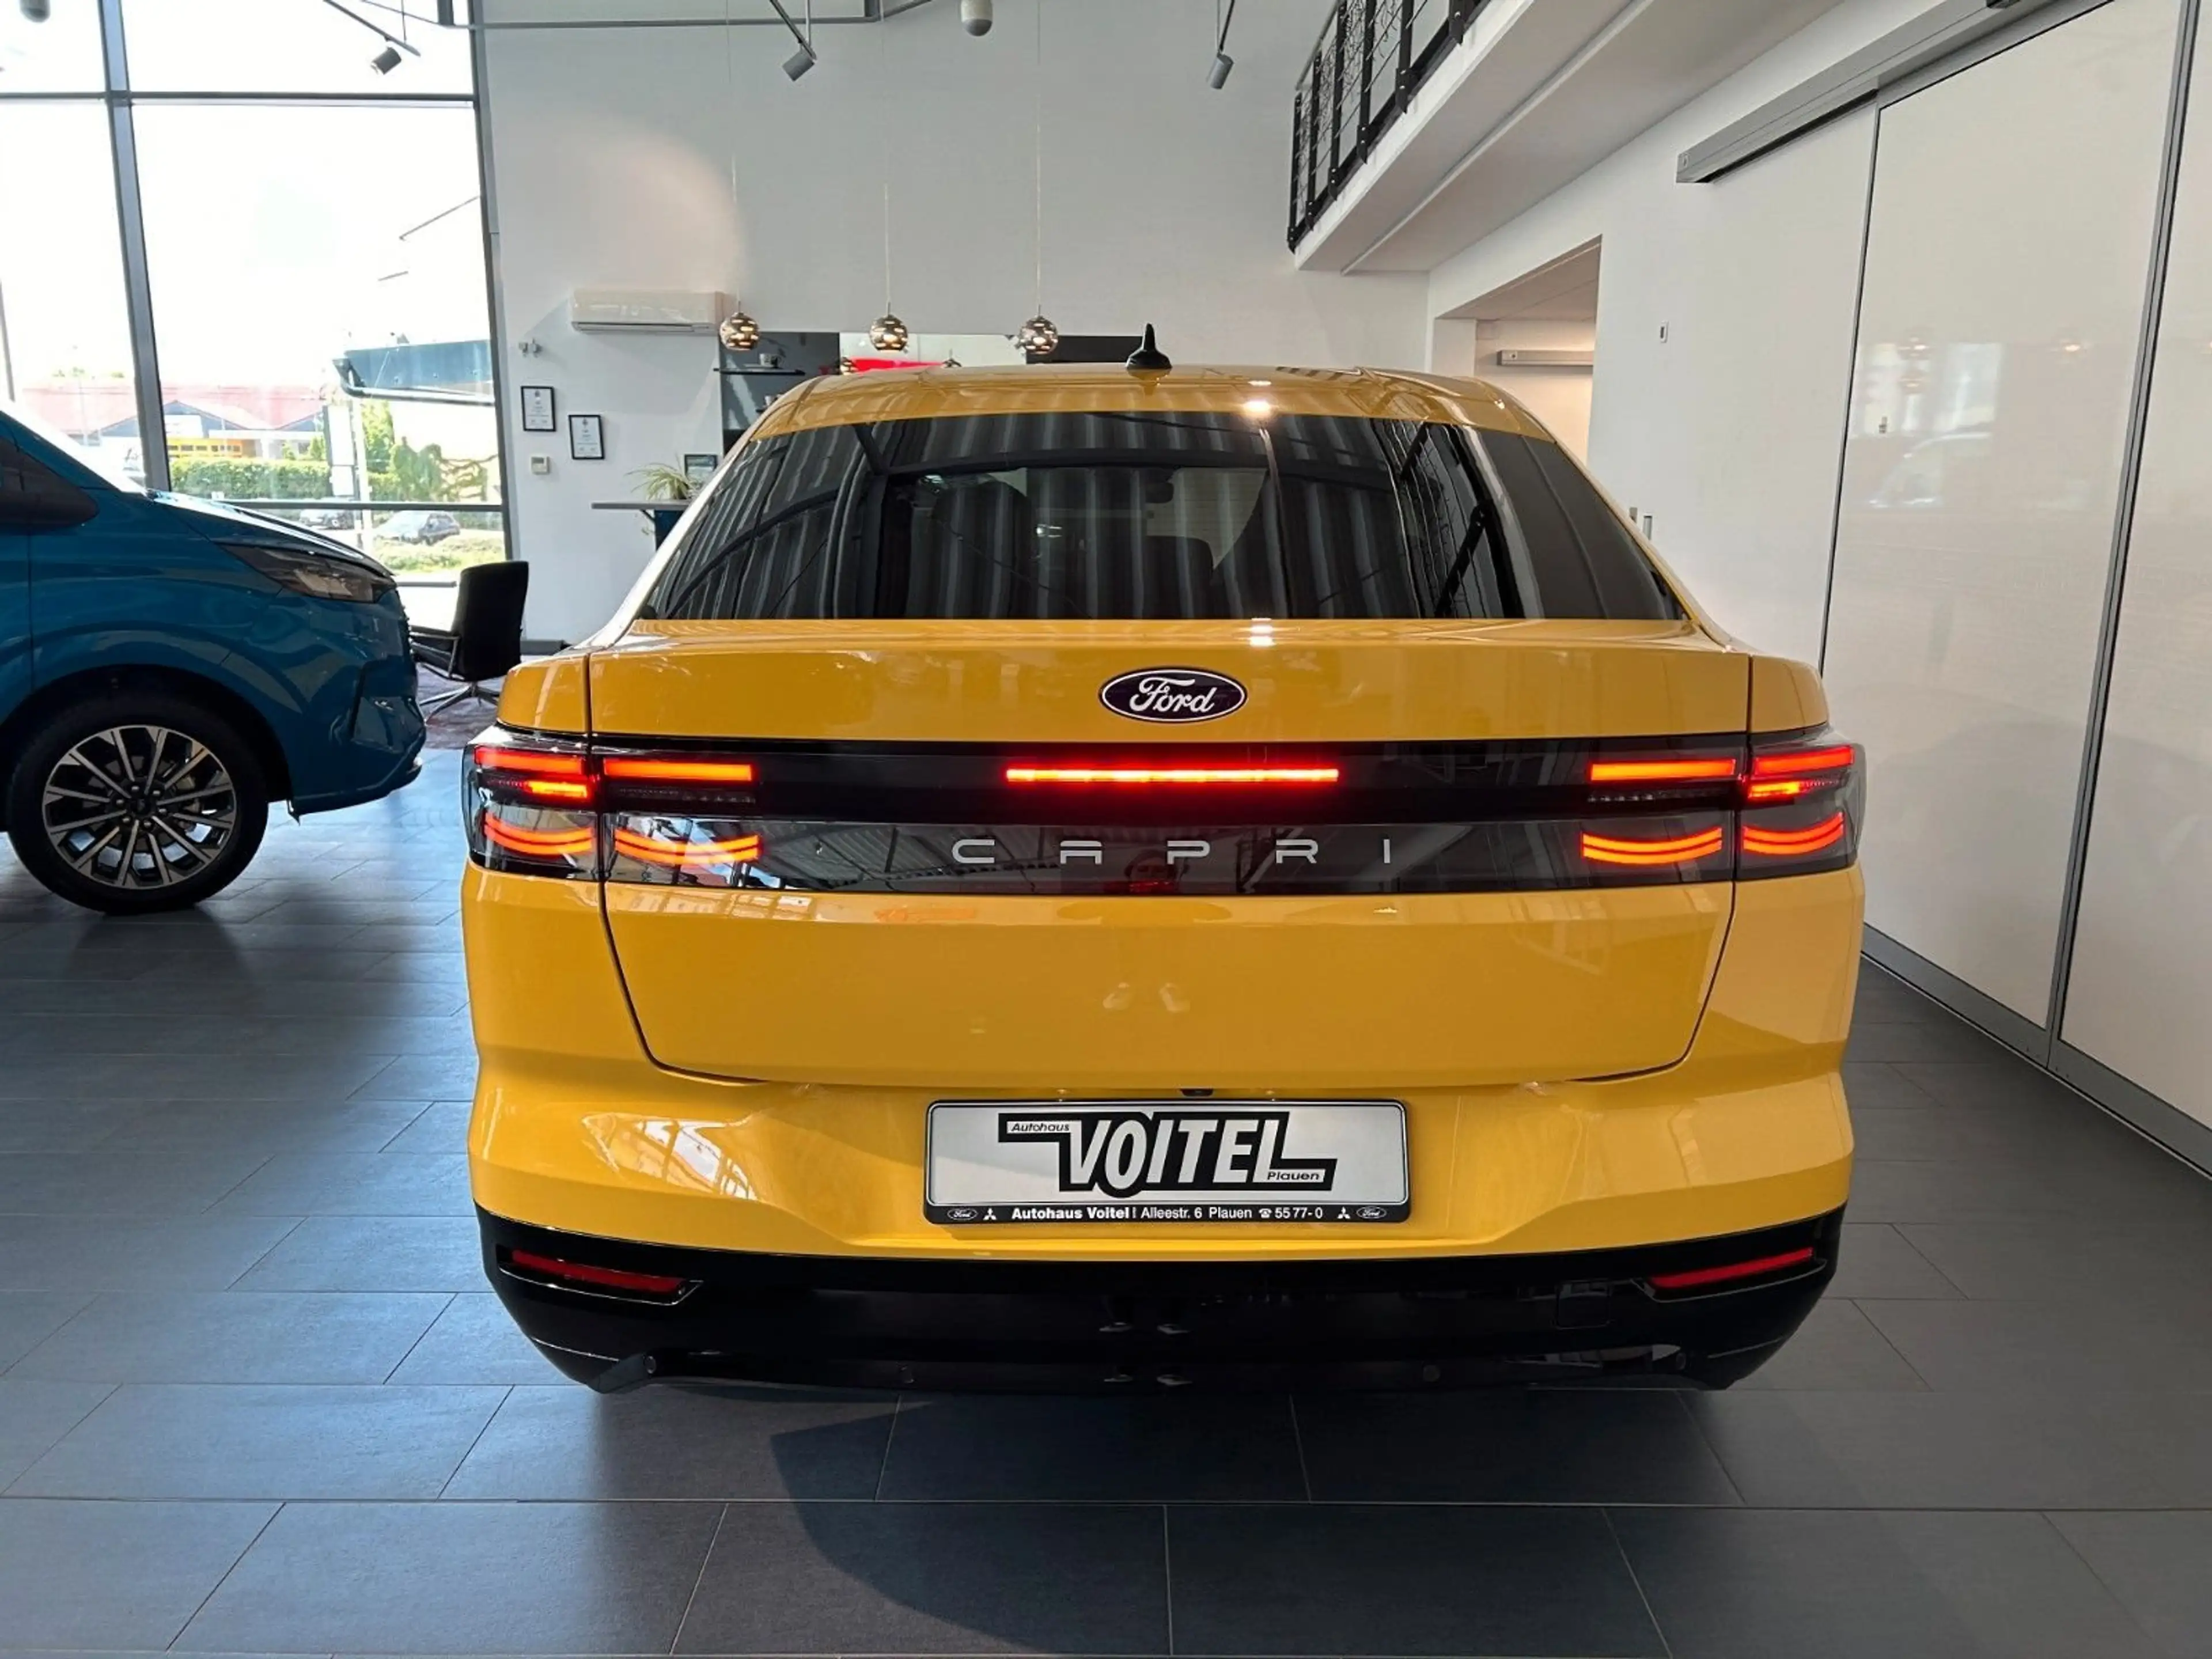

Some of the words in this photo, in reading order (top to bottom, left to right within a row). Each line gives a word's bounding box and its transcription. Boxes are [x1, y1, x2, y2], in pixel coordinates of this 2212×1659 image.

[1129, 676, 1217, 713] Ford
[951, 839, 1391, 864] CAPRI
[1010, 1122, 1070, 1132] Autohaus
[1070, 1119, 1280, 1190] VOITEL
[1266, 1170, 1320, 1181] Plauen
[1011, 1207, 1083, 1219] Autohaus
[1086, 1207, 1130, 1219] Voitel
[1140, 1206, 1191, 1219] Alleestr.
[1194, 1206, 1203, 1219] 6
[1209, 1206, 1252, 1219] Plauen
